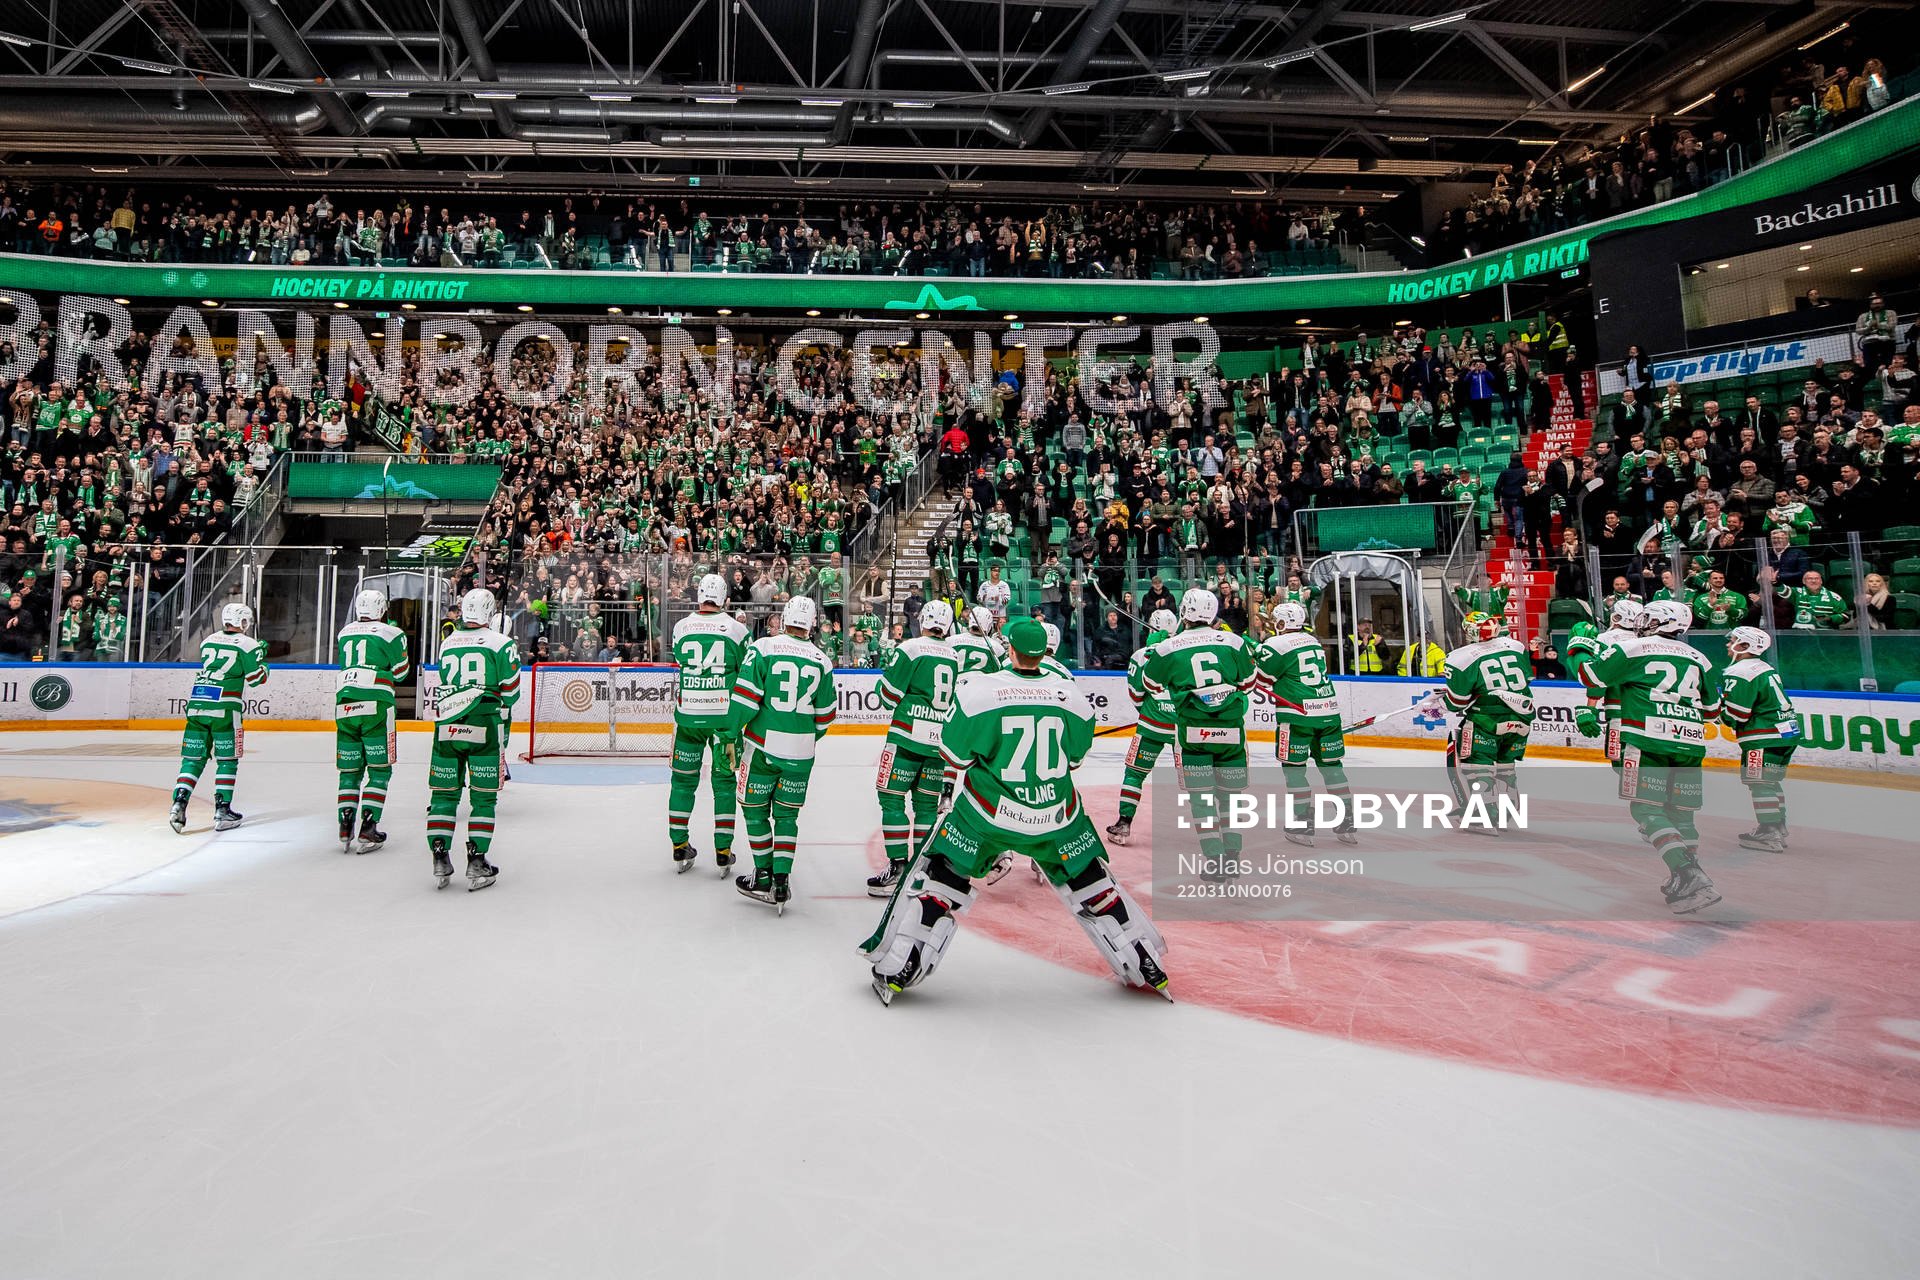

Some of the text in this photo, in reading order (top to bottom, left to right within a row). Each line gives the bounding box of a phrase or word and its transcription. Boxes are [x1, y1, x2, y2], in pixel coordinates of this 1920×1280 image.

[1754, 184, 1900, 236] Backahill
[272, 273, 469, 299] HOCKEY PÅ RIKTIGT
[1388, 238, 1589, 303] HOCKEY PÅ RIKTI
[776, 320, 1226, 416] CENTER
[201, 647, 238, 680] 27
[343, 639, 367, 667] 11
[681, 640, 726, 675] 34
[1191, 651, 1222, 688] 6
[770, 661, 821, 715] 32
[931, 663, 953, 710] 8
[1480, 655, 1527, 691] 65
[1644, 661, 1702, 708] 24
[1253, 709, 1275, 722] För
[1000, 715, 1069, 782] 70
[1211, 730, 1227, 738] golv
[1609, 730, 1617, 755] ER-HO
[877, 753, 890, 784] ER-HO
[1623, 760, 1633, 793] ER-HO
[1015, 783, 1056, 805] CLANG
[999, 804, 1051, 824] Backahill
[944, 821, 979, 848] CERNITOL
[945, 833, 978, 856] NOVUM
[1068, 836, 1096, 859] NOVUM
